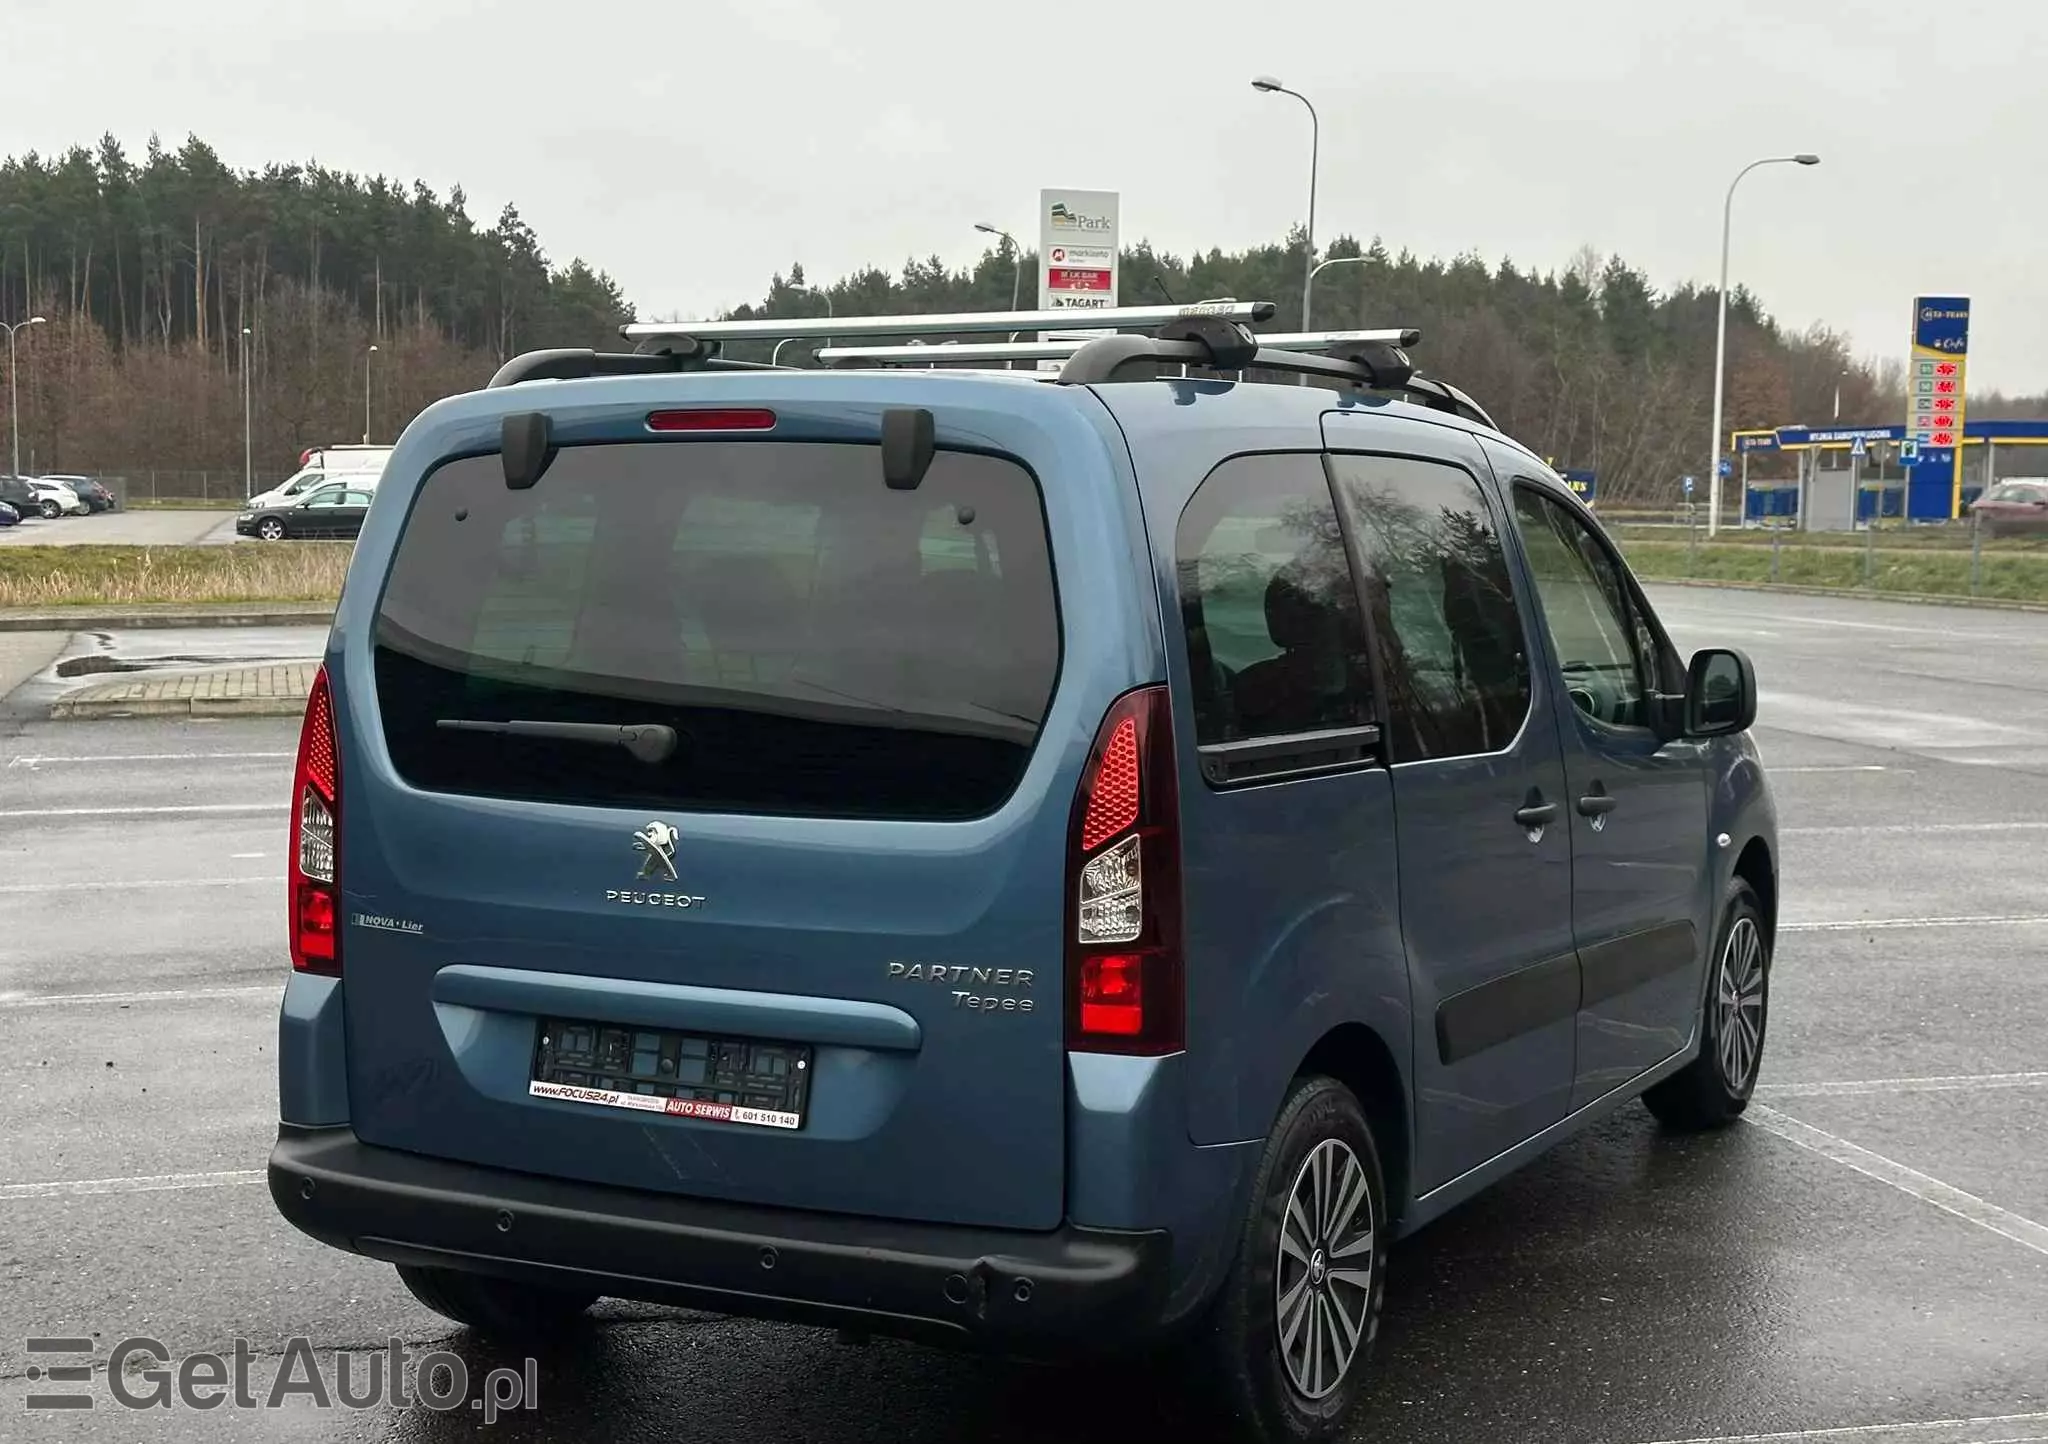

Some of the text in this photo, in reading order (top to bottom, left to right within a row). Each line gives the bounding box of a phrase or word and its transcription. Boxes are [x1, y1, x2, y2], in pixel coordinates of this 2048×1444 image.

[1078, 215, 1110, 229] Park
[1065, 298, 1105, 308] TAGART
[605, 890, 706, 908] PEUGEOT
[888, 962, 1035, 986] PARTNER
[951, 990, 1034, 1013] Tepee
[533, 1084, 619, 1104] www.FOCUS24.pl
[667, 1101, 693, 1114] AUTO
[695, 1104, 731, 1119] SERWIS
[742, 1111, 758, 1120] 601
[760, 1114, 777, 1123] 510
[779, 1116, 795, 1126] 140
